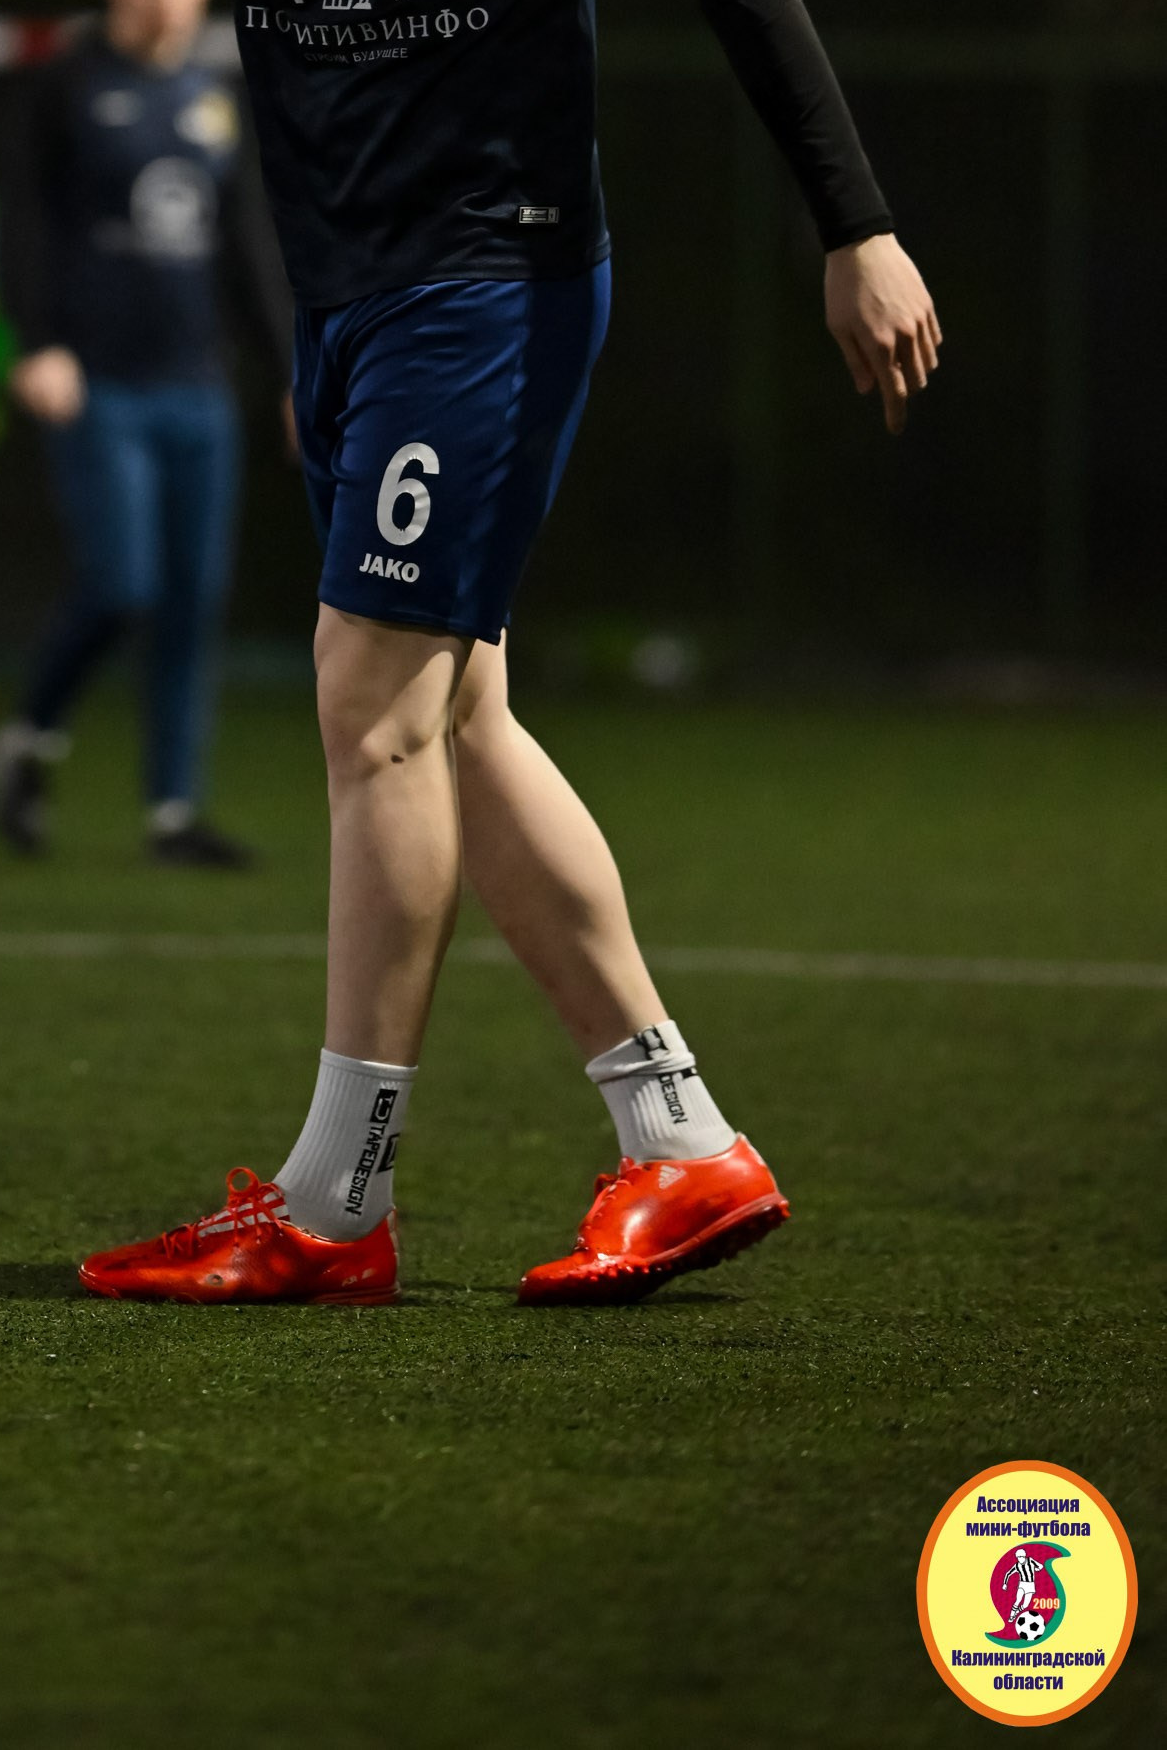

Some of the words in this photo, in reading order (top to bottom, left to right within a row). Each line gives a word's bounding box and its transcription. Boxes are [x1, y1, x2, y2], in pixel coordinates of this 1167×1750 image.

[376, 441, 440, 547] 6
[359, 552, 421, 584] JAKO
[344, 1123, 386, 1217] TAPEDESIGN
